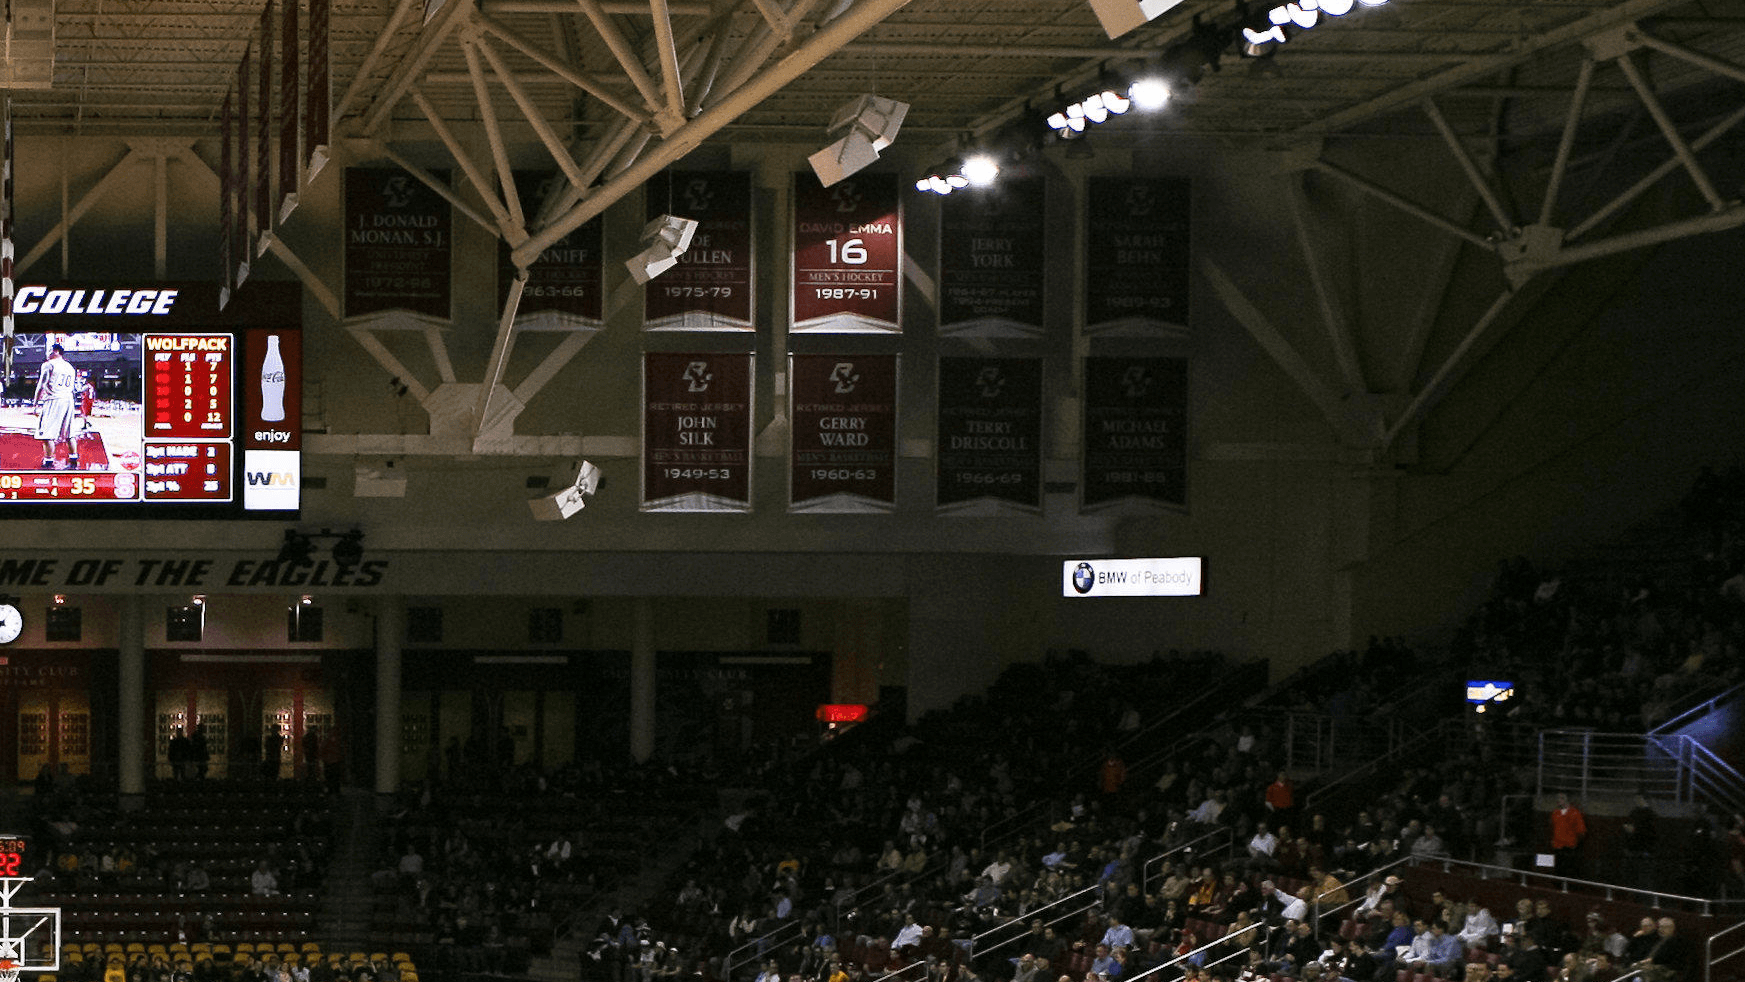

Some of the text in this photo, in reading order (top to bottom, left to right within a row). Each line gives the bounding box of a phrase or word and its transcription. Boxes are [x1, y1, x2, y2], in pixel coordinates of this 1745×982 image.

[359, 215, 438, 228] J. DONALD
[799, 223, 892, 234] DAVID EMMA
[826, 239, 868, 264] 16
[972, 254, 1014, 267] YORK
[809, 273, 884, 281] MEN'S HOCKEY
[665, 287, 731, 297] 1975-79
[815, 288, 877, 300] 1987-91
[13, 286, 179, 315] COLLEGE
[147, 338, 227, 351] WOLFPACK
[184, 362, 217, 371] 1 7
[184, 374, 217, 384] 1 7
[184, 399, 217, 409] 2 5
[184, 413, 221, 422] 0 12
[678, 417, 716, 430] JOHN
[820, 417, 867, 430] GERRY
[966, 421, 1012, 434] TERRY
[1103, 420, 1169, 433] MICHAEL
[254, 429, 291, 443] enjoy
[680, 433, 714, 445] SILK
[820, 433, 869, 446] WARD
[951, 437, 1028, 450] DRISCOLL
[1108, 437, 1164, 449] ADAMS
[166, 463, 189, 475] ATT
[664, 468, 730, 479] 1949-53
[811, 469, 877, 480] 1960-63
[956, 473, 1022, 484] 1966-69
[70, 478, 96, 494] 35
[67, 559, 125, 587] OF
[134, 559, 217, 587] THE
[225, 559, 392, 588] EAGLES
[1098, 570, 1193, 588] BMW of Peabody
[38, 666, 78, 676] CLUB
